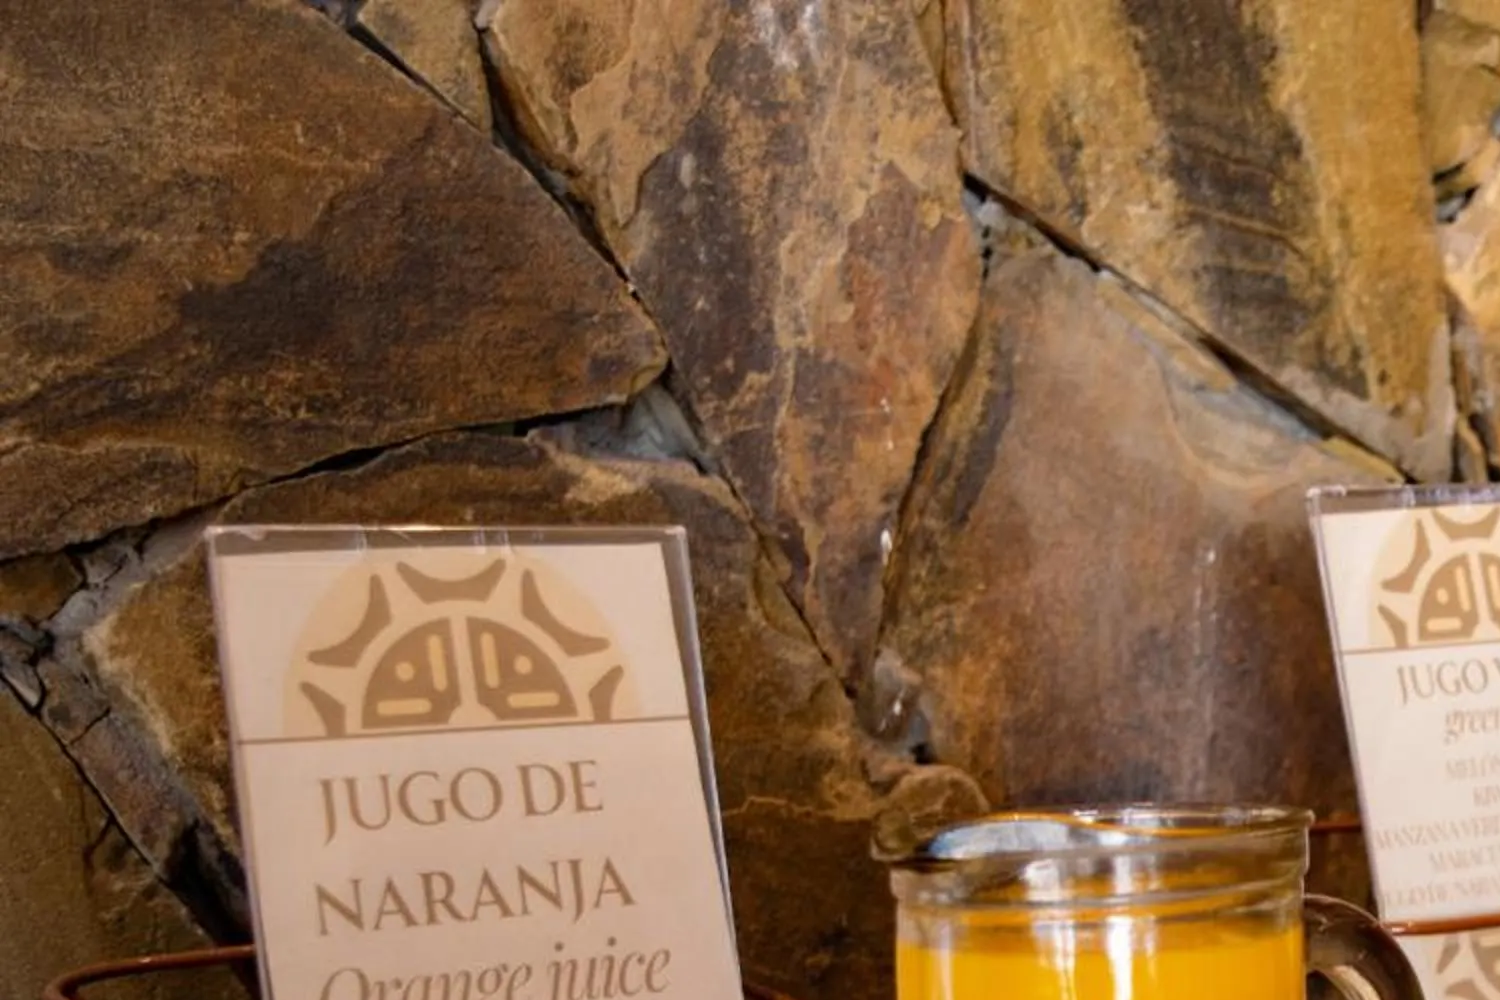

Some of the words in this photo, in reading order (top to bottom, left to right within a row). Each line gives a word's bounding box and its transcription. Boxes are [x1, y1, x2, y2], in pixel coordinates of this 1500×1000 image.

[1397, 659, 1489, 705] JUGO
[318, 767, 502, 845] JUGO
[516, 759, 605, 818] DE
[313, 856, 637, 937] NARANJA
